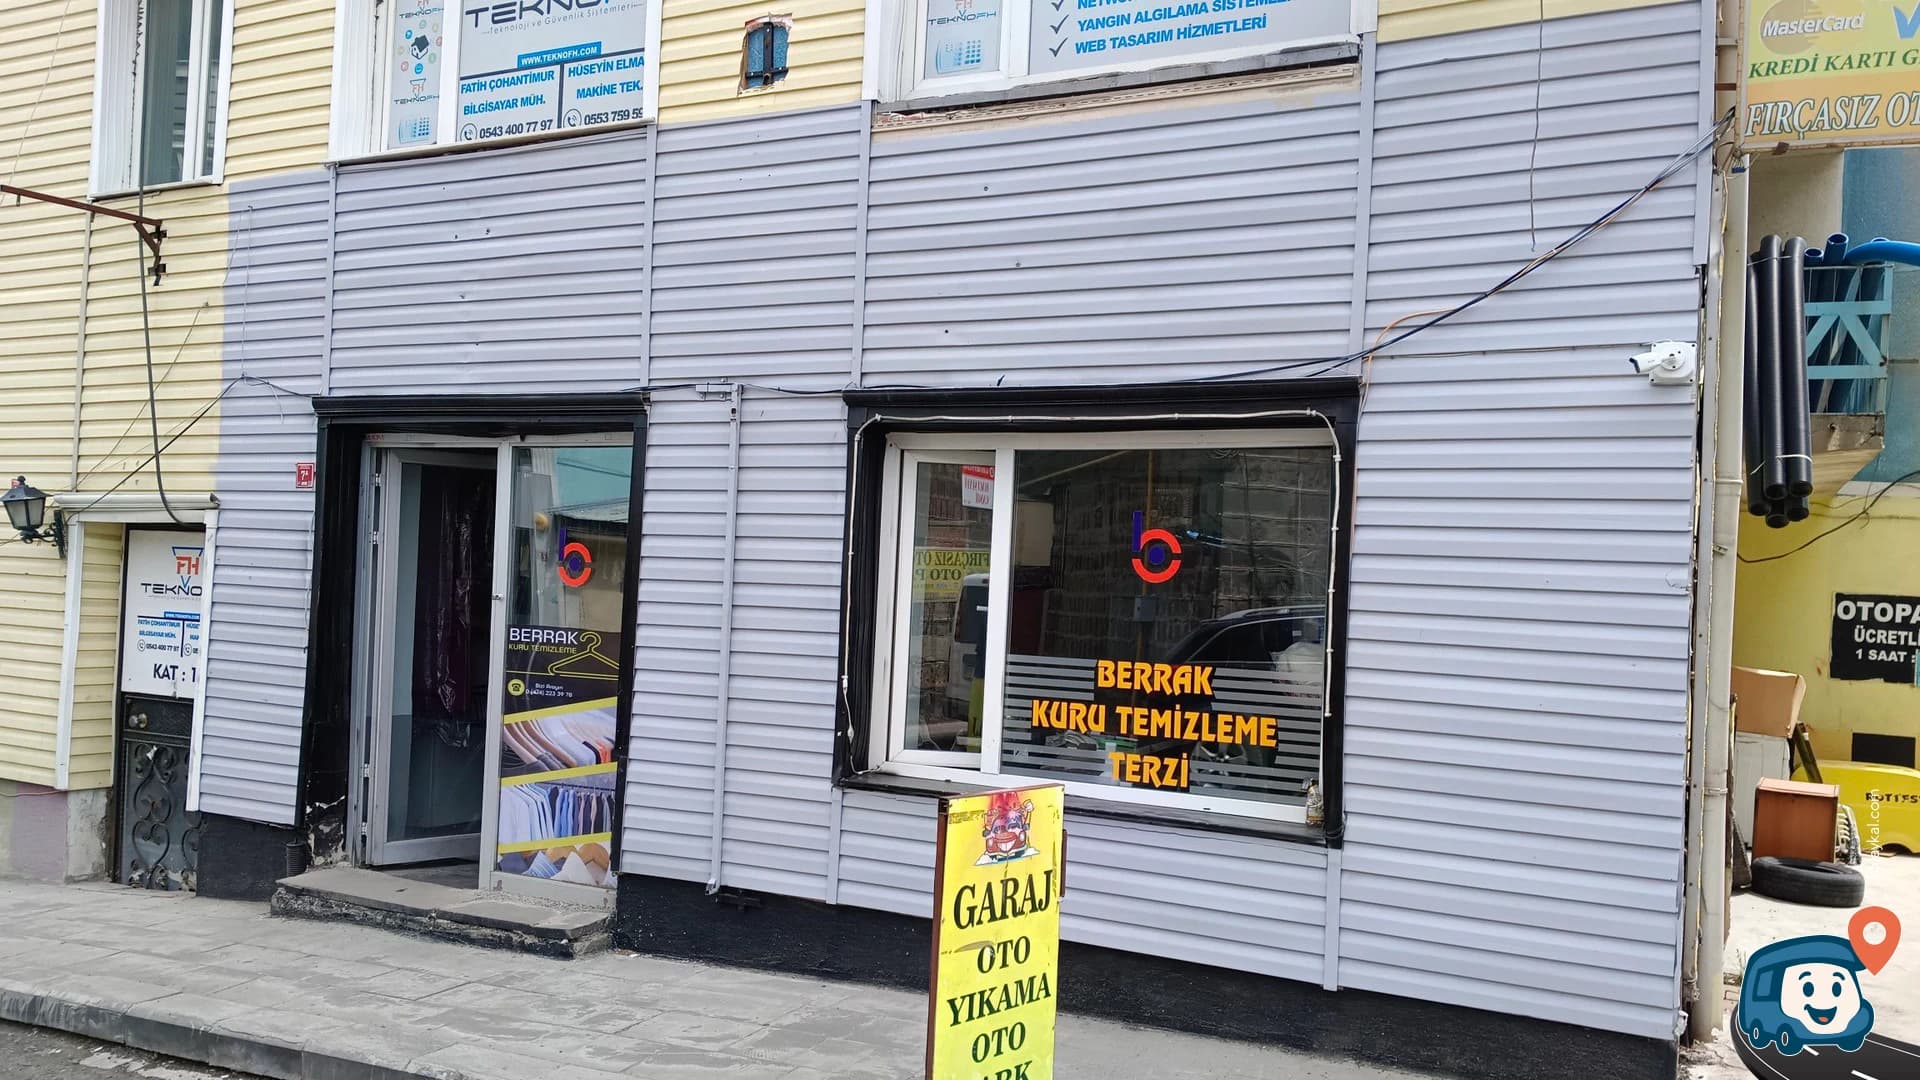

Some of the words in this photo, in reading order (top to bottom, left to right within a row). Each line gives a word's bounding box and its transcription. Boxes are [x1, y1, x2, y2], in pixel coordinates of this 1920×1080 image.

[399, 8, 444, 19] TEKNOFH
[490, 23, 530, 35] Teknoloji
[544, 12, 584, 25] Güvenlik
[587, 4, 635, 18] Sistemleri
[928, 11, 997, 25] TEKNOFH
[1078, 13, 1131, 32] YANGIN
[1134, 4, 1208, 24] ALGILAMA
[1075, 39, 1106, 54] WEB
[1109, 29, 1173, 50] TASARIM
[1176, 13, 1267, 39] HİZMETLERİ
[1762, 13, 1866, 37] MasterCard
[521, 47, 598, 66] WWW.TEKNOFH.COM
[568, 56, 613, 77] HÜSEYİN
[1748, 53, 1820, 78] KREDİ
[1824, 51, 1896, 72] KARTI
[1902, 49, 1920, 66] G
[460, 78, 487, 94] FATİH
[489, 70, 555, 94] ÇOHANTİMUR
[576, 83, 617, 99] MAKİNE
[620, 80, 643, 93] TEK.
[394, 94, 440, 104] TEKNOFH
[463, 98, 518, 116] BİLGİSAYAR
[520, 94, 546, 107] MÜH.
[584, 112, 609, 125] 0553
[611, 109, 630, 122] 759
[1744, 94, 1882, 140] FIRÇASIZ
[479, 125, 503, 139] 0543
[505, 123, 524, 136] 400
[526, 121, 538, 131] 77
[540, 119, 553, 130] 97
[141, 583, 203, 597] TEKNO
[509, 627, 579, 645] BERRAK
[1854, 625, 1920, 646] ÜCRETL
[508, 643, 529, 651] KURU
[1855, 648, 1863, 660] 1
[1868, 649, 1908, 663] SAAT
[153, 663, 179, 681] KAT
[190, 667, 197, 683] 1
[1096, 658, 1215, 696] BERRAK
[1031, 699, 1106, 734] KURU
[1115, 703, 1279, 748] TEMİZLEME
[1108, 751, 1190, 788] TERZİ
[953, 869, 1054, 930] GARAJ
[976, 935, 1031, 974] OTO
[946, 972, 1052, 1028] YIKAMA
[972, 1021, 1027, 1064] OTO
